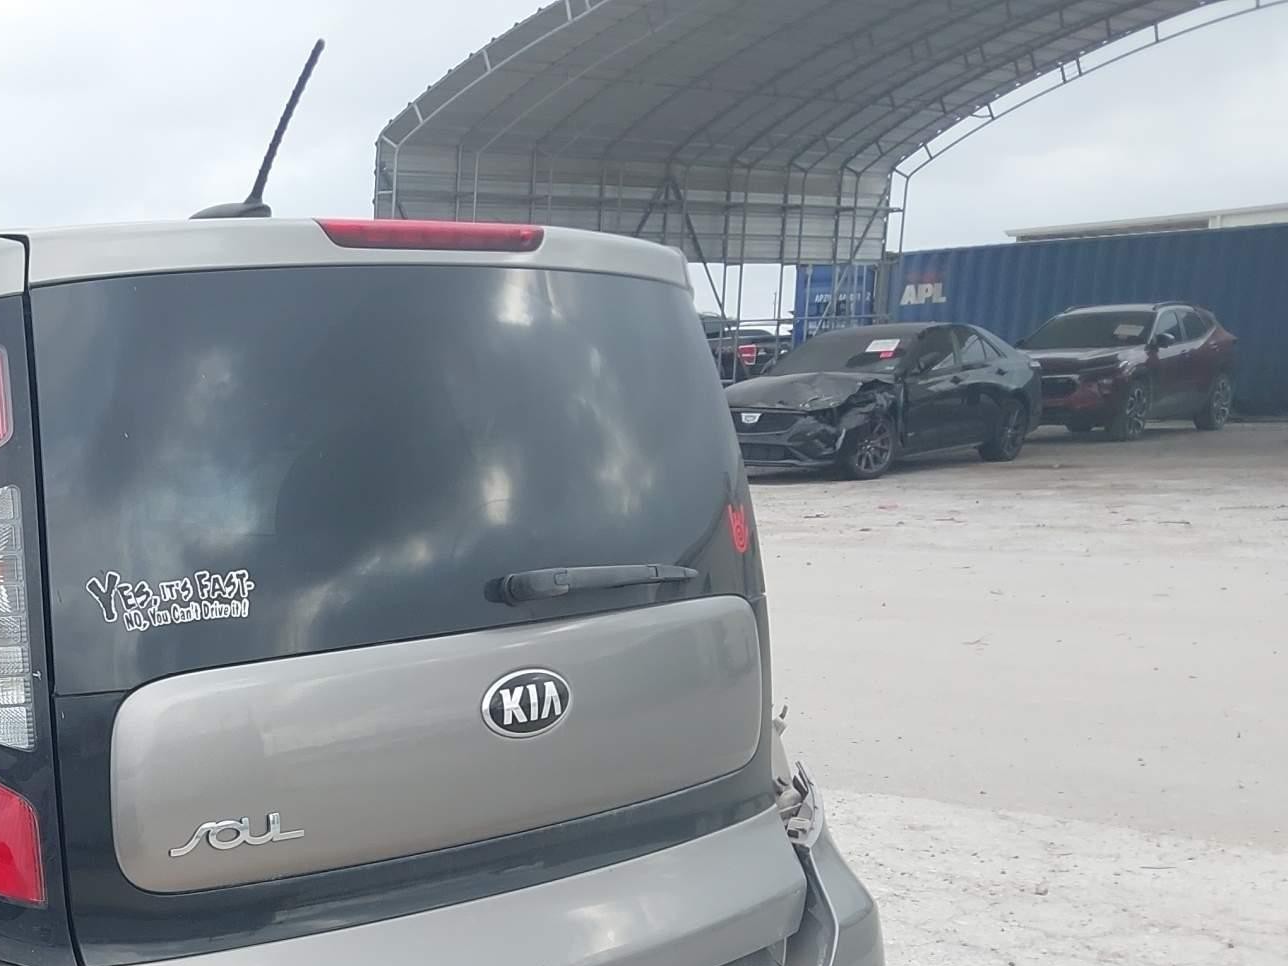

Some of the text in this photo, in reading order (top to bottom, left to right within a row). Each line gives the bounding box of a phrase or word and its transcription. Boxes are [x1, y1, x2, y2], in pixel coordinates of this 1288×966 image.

[901, 283, 946, 305] APL
[148, 606, 171, 627] You
[171, 601, 201, 624] Can't
[202, 600, 230, 619] Drive
[499, 680, 562, 725] KIA
